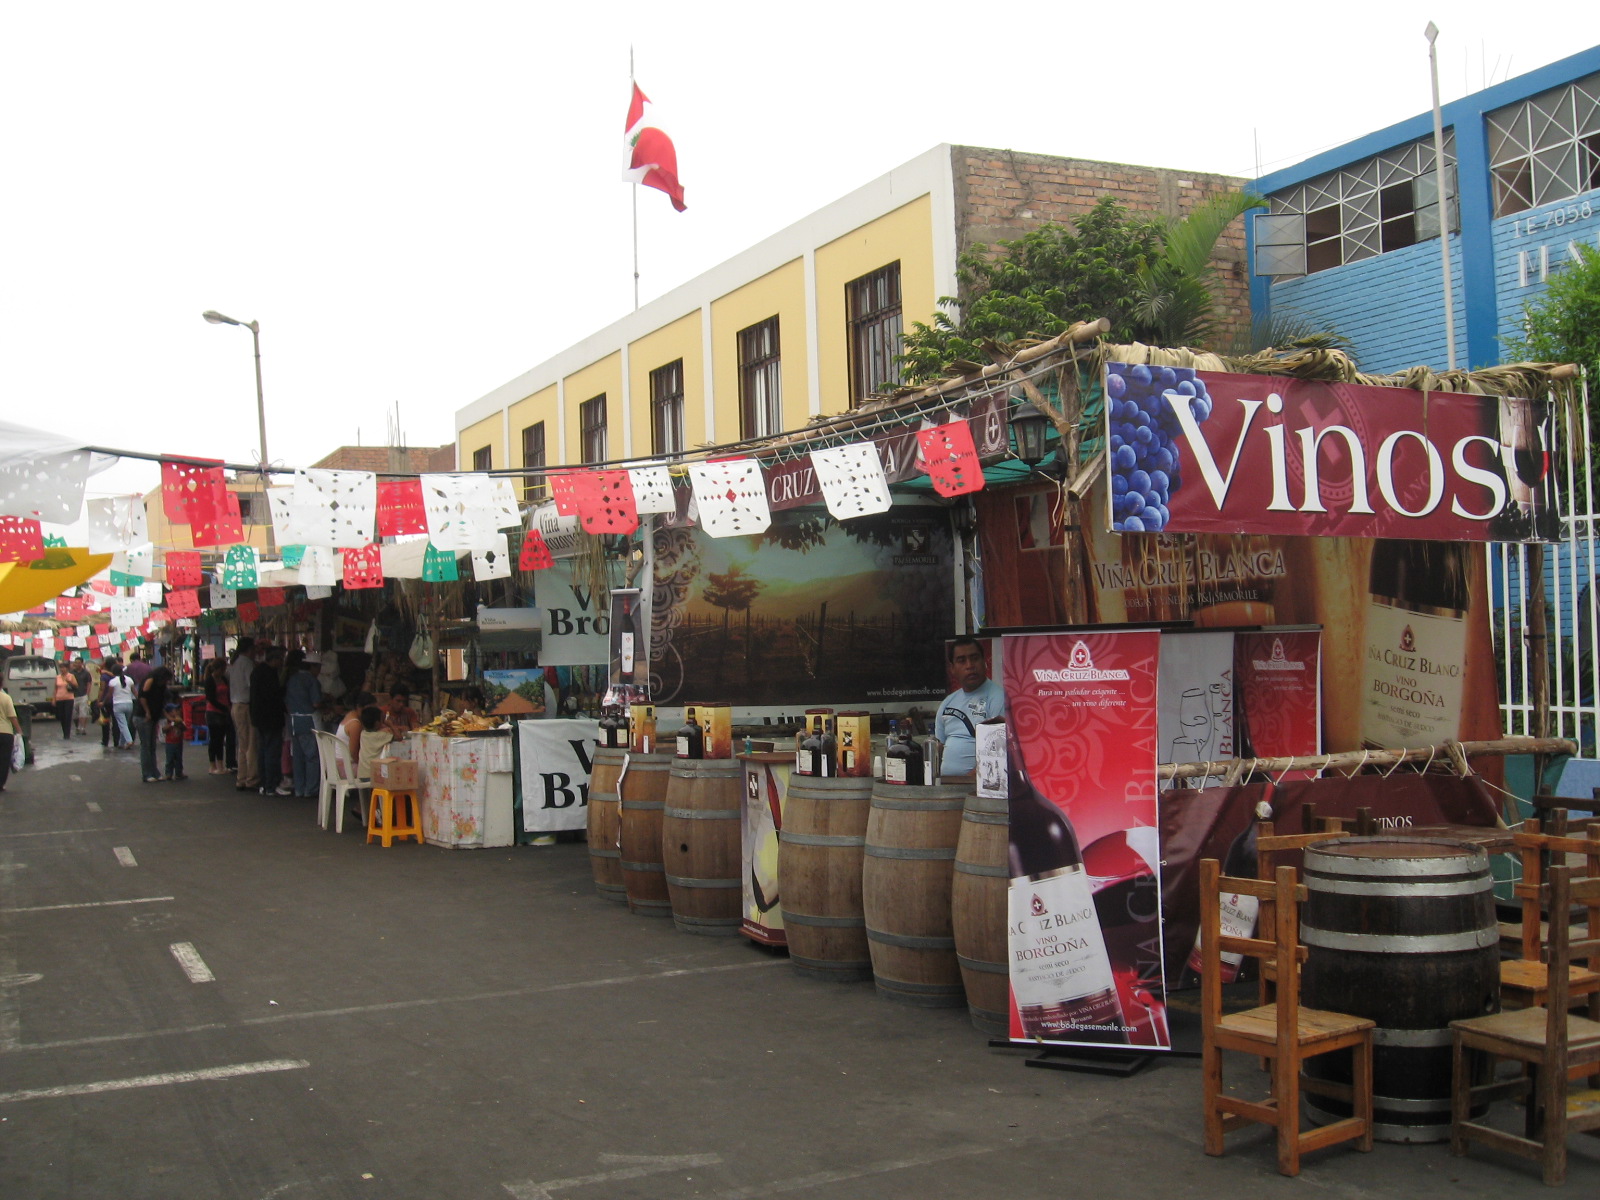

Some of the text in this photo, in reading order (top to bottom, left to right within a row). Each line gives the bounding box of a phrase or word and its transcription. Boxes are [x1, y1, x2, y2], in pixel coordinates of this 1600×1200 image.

[1163, 392, 1507, 521] Vinos
[770, 466, 814, 503] CRUZ
[540, 512, 560, 535] Viña
[1094, 550, 1286, 590] VIÑA CRUZ BLANCA
[1123, 596, 1152, 609] ODEGAS
[1384, 649, 1416, 671] CRUZ
[1034, 670, 1129, 681] VIÑA CRUZ BLANCA
[1396, 675, 1417, 688] VINO
[866, 687, 946, 697] www.bodegasemorile.com
[1038, 689, 1053, 697] Para
[1091, 689, 1118, 699] exigente
[1373, 679, 1445, 708] BORGOÑA
[1098, 699, 1127, 709] diferente
[1125, 655, 1157, 804] BLANCA
[1018, 918, 1053, 935] CZ
[1220, 923, 1243, 937] GOÑA
[1036, 934, 1058, 946] VINO
[1015, 937, 1089, 962] BORGOÑA
[1041, 1018, 1138, 1032] www.bodegasemorile.com
